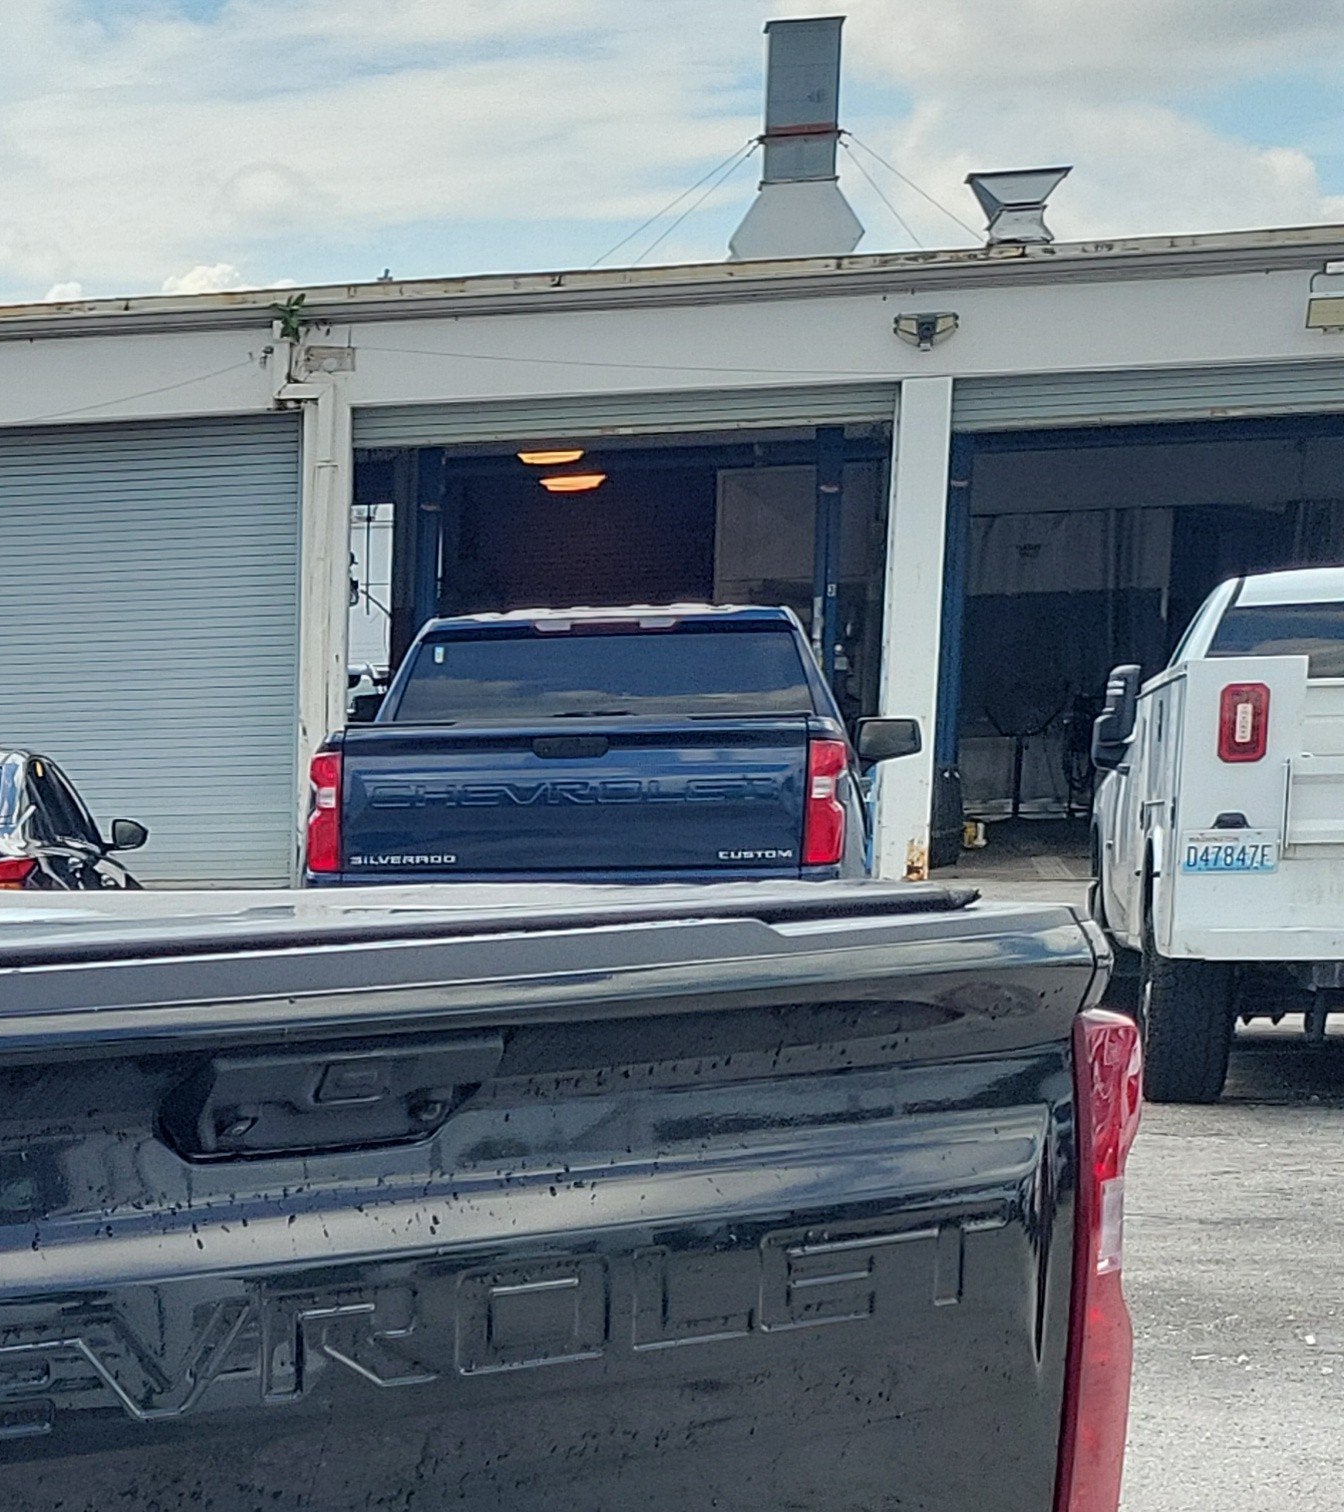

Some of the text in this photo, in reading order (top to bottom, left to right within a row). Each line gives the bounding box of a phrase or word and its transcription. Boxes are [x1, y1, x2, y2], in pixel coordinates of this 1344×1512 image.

[370, 774, 779, 808] CHEVROLET
[349, 854, 457, 865] SILVERADO
[718, 849, 793, 860] CUSTOM
